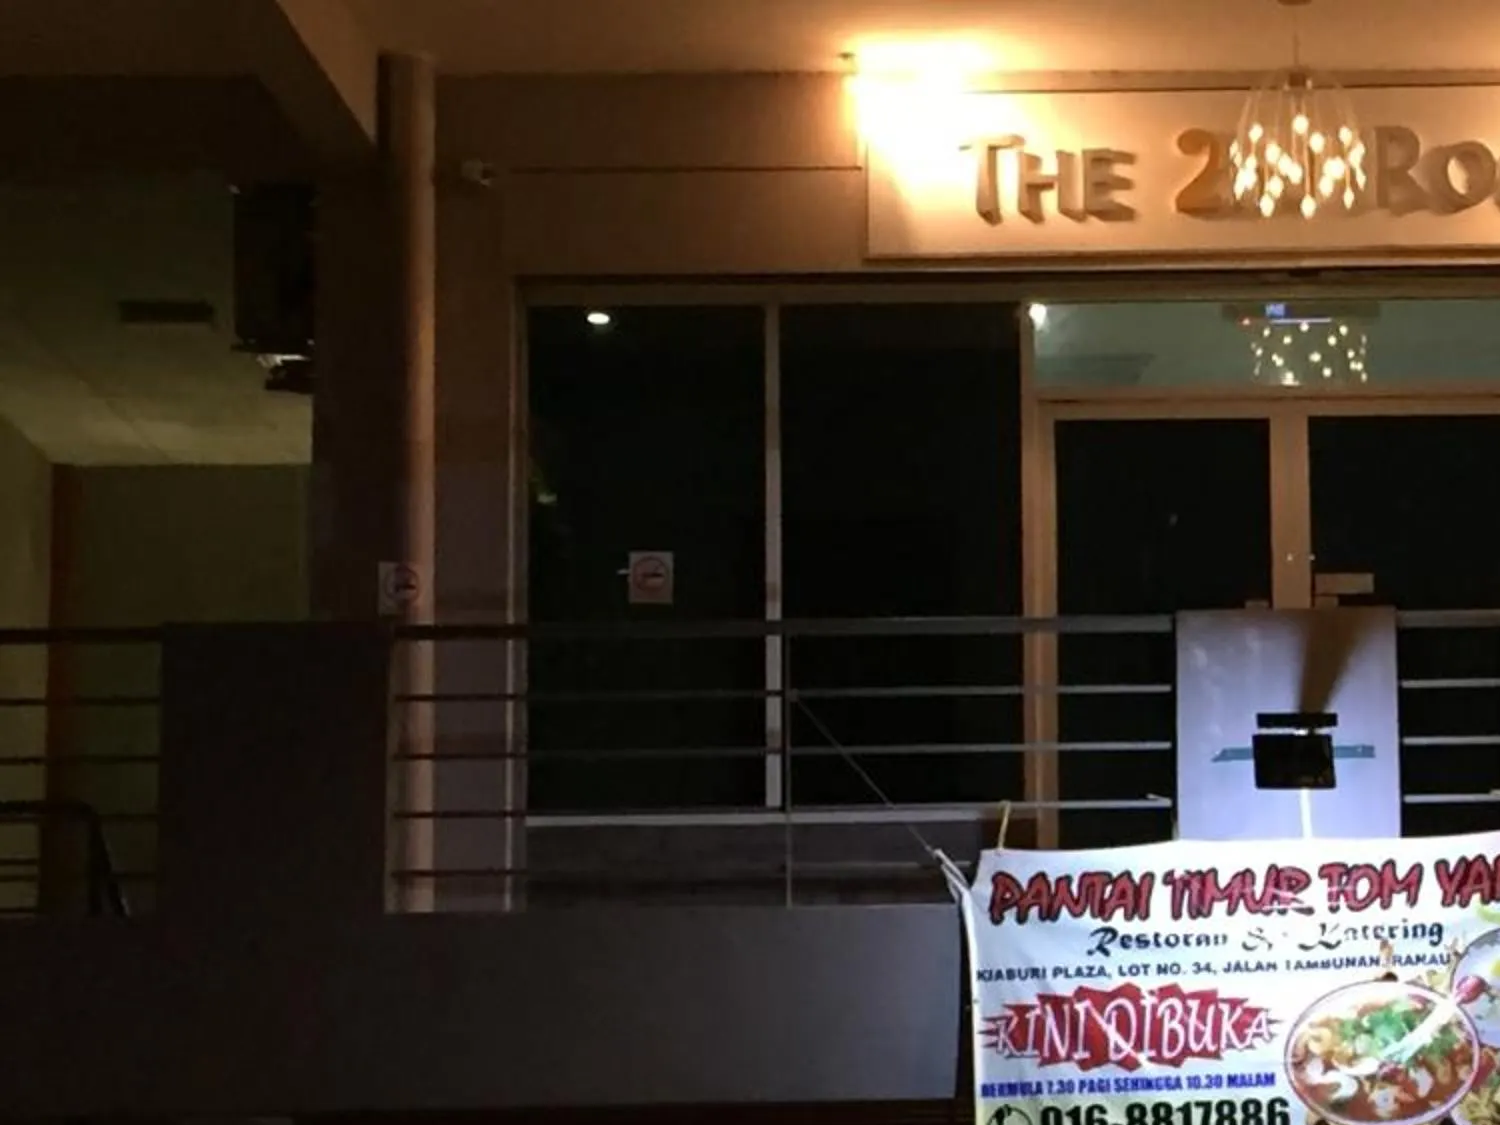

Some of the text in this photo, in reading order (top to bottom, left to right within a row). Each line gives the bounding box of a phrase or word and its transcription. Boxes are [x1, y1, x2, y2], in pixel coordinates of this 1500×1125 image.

[989, 870, 1155, 926] PANTAI
[1162, 863, 1314, 921] TIMUR
[1318, 858, 1424, 914] TOM
[1087, 926, 1228, 957] Restoran
[1052, 964, 1112, 980] PLAZA,
[1118, 963, 1151, 977] LOT
[1156, 962, 1186, 976] NO.
[1192, 960, 1218, 975] 34,
[1222, 957, 1278, 974] JALAN
[995, 999, 1091, 1061] KINI
[1078, 1076, 1111, 1094] PAGI
[1227, 1071, 1276, 1089] MALAM
